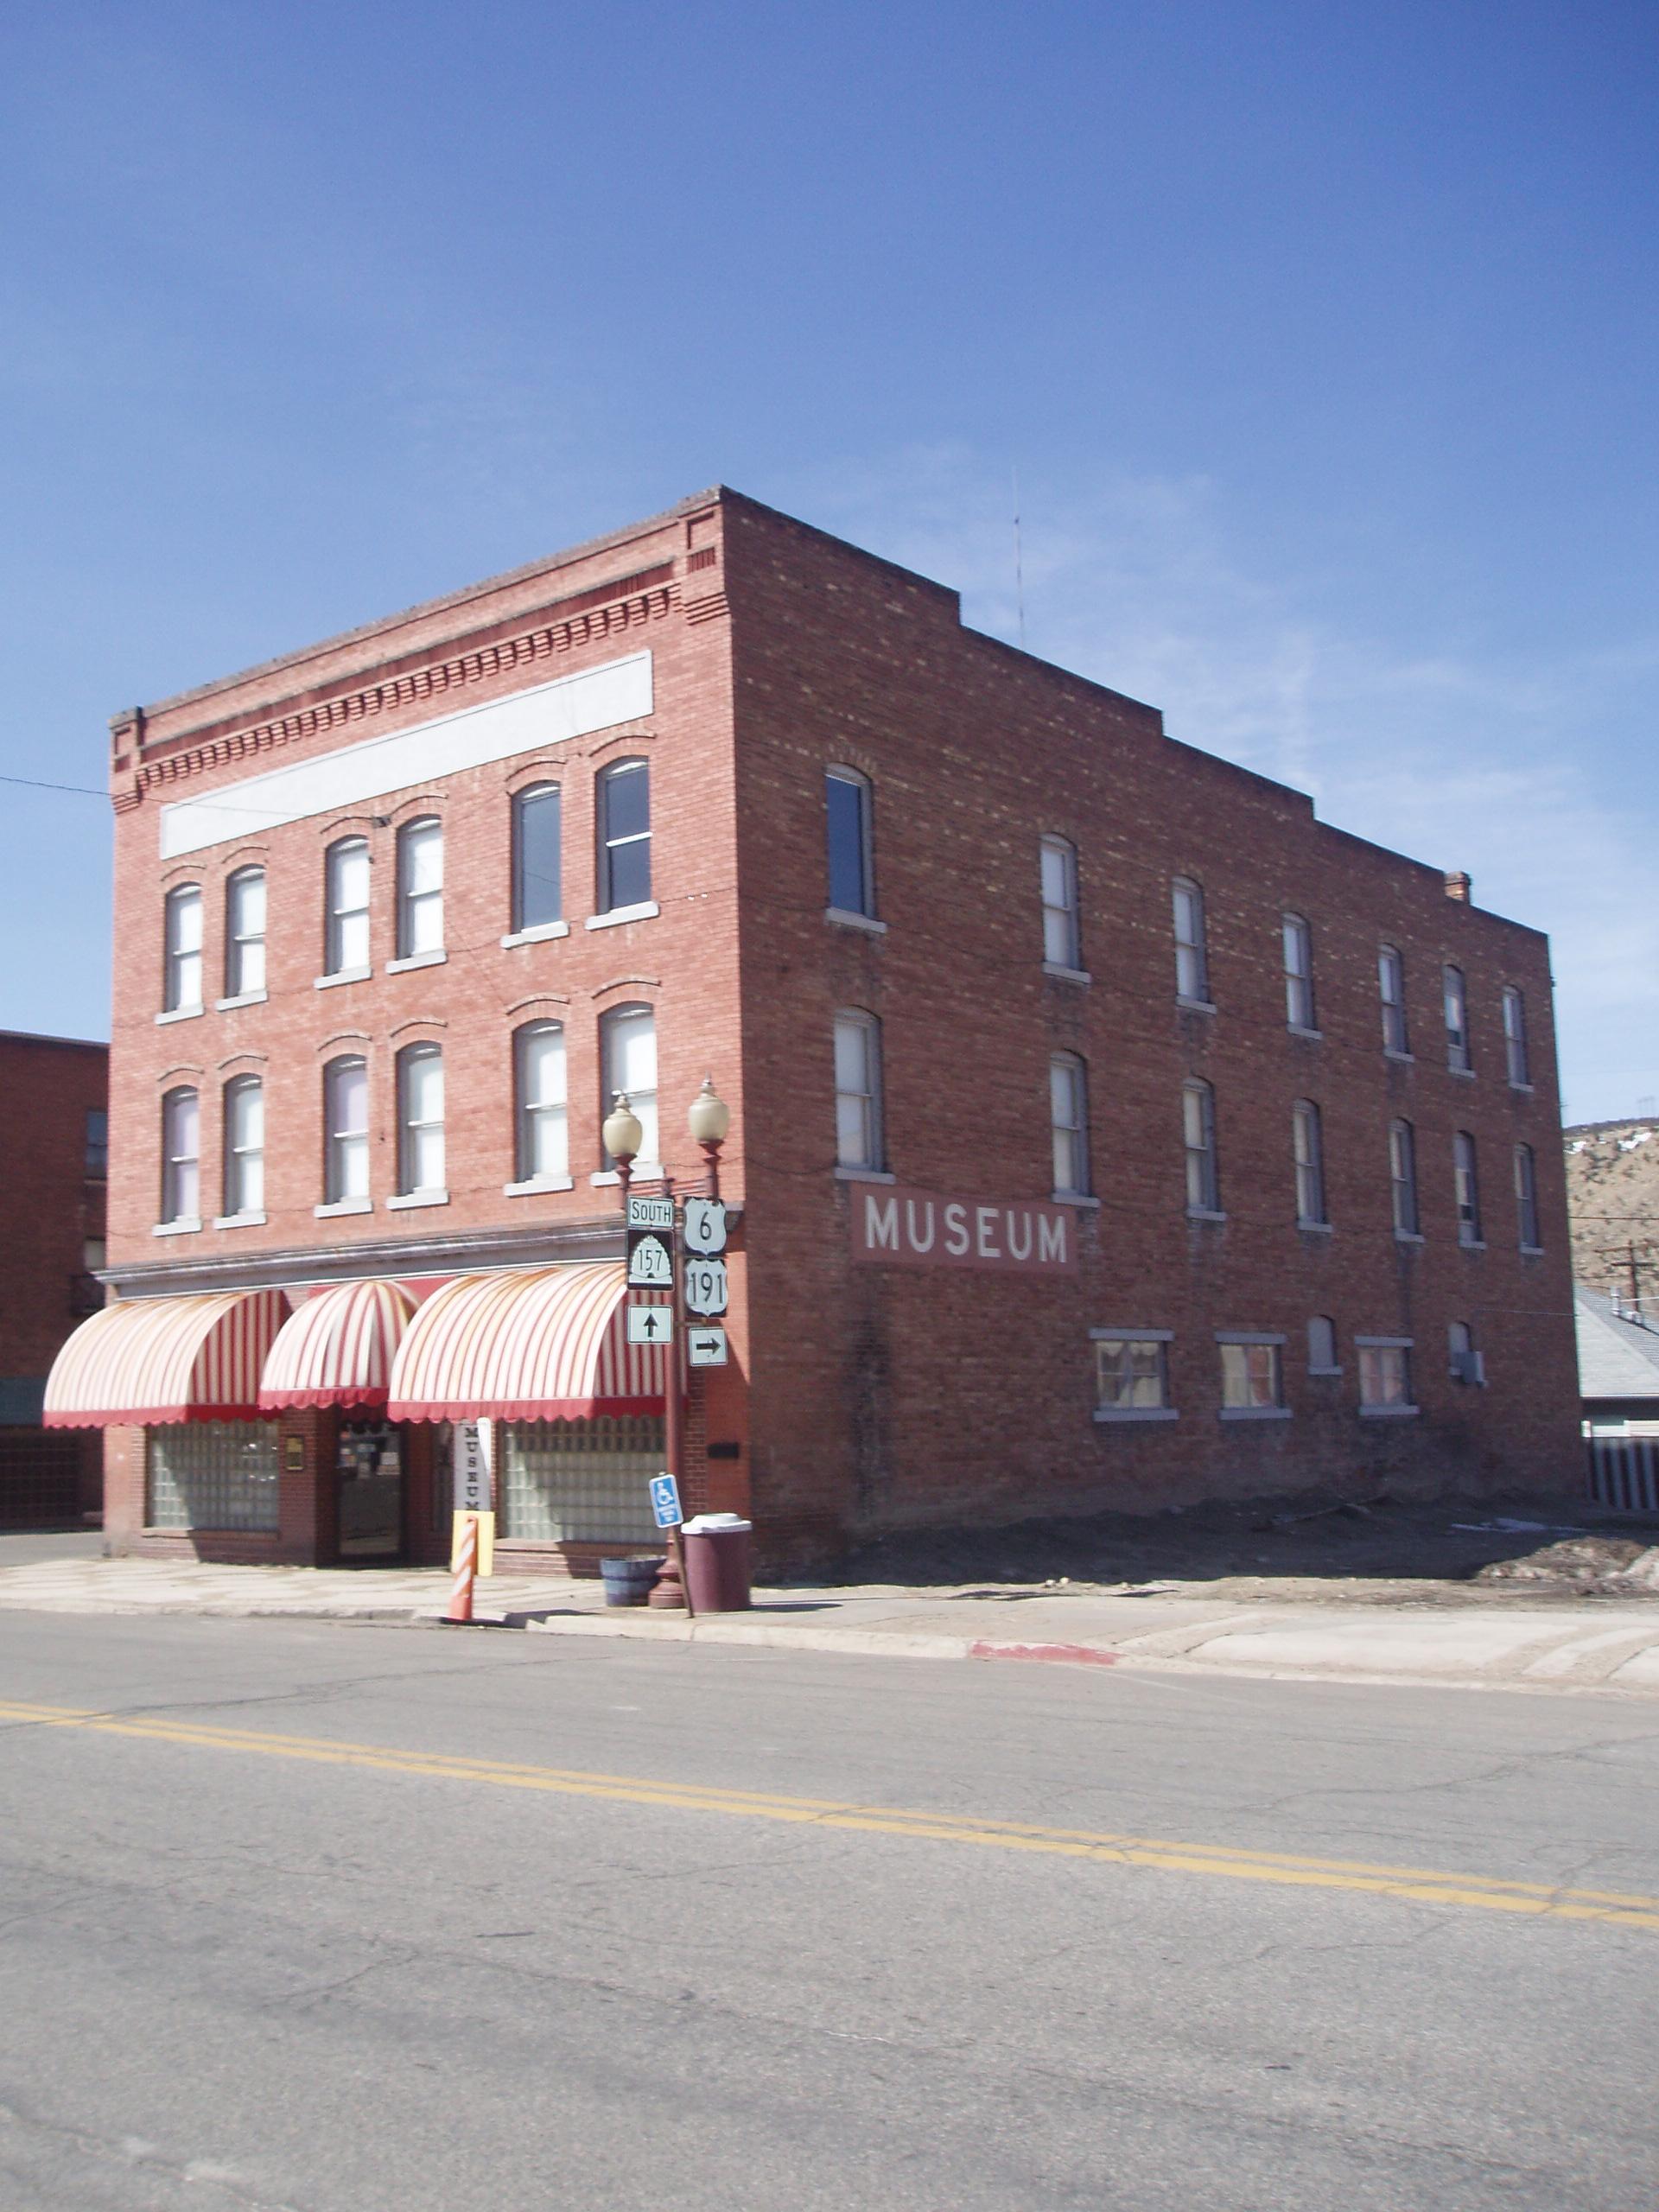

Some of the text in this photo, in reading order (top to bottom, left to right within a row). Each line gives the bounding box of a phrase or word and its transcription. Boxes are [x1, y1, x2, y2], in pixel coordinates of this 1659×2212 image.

[632, 1201, 671, 1223] SOUTH
[699, 1211, 712, 1241] 6
[865, 1195, 1067, 1263] MUSEUM
[639, 1249, 663, 1272] 157
[690, 1272, 724, 1305] 191
